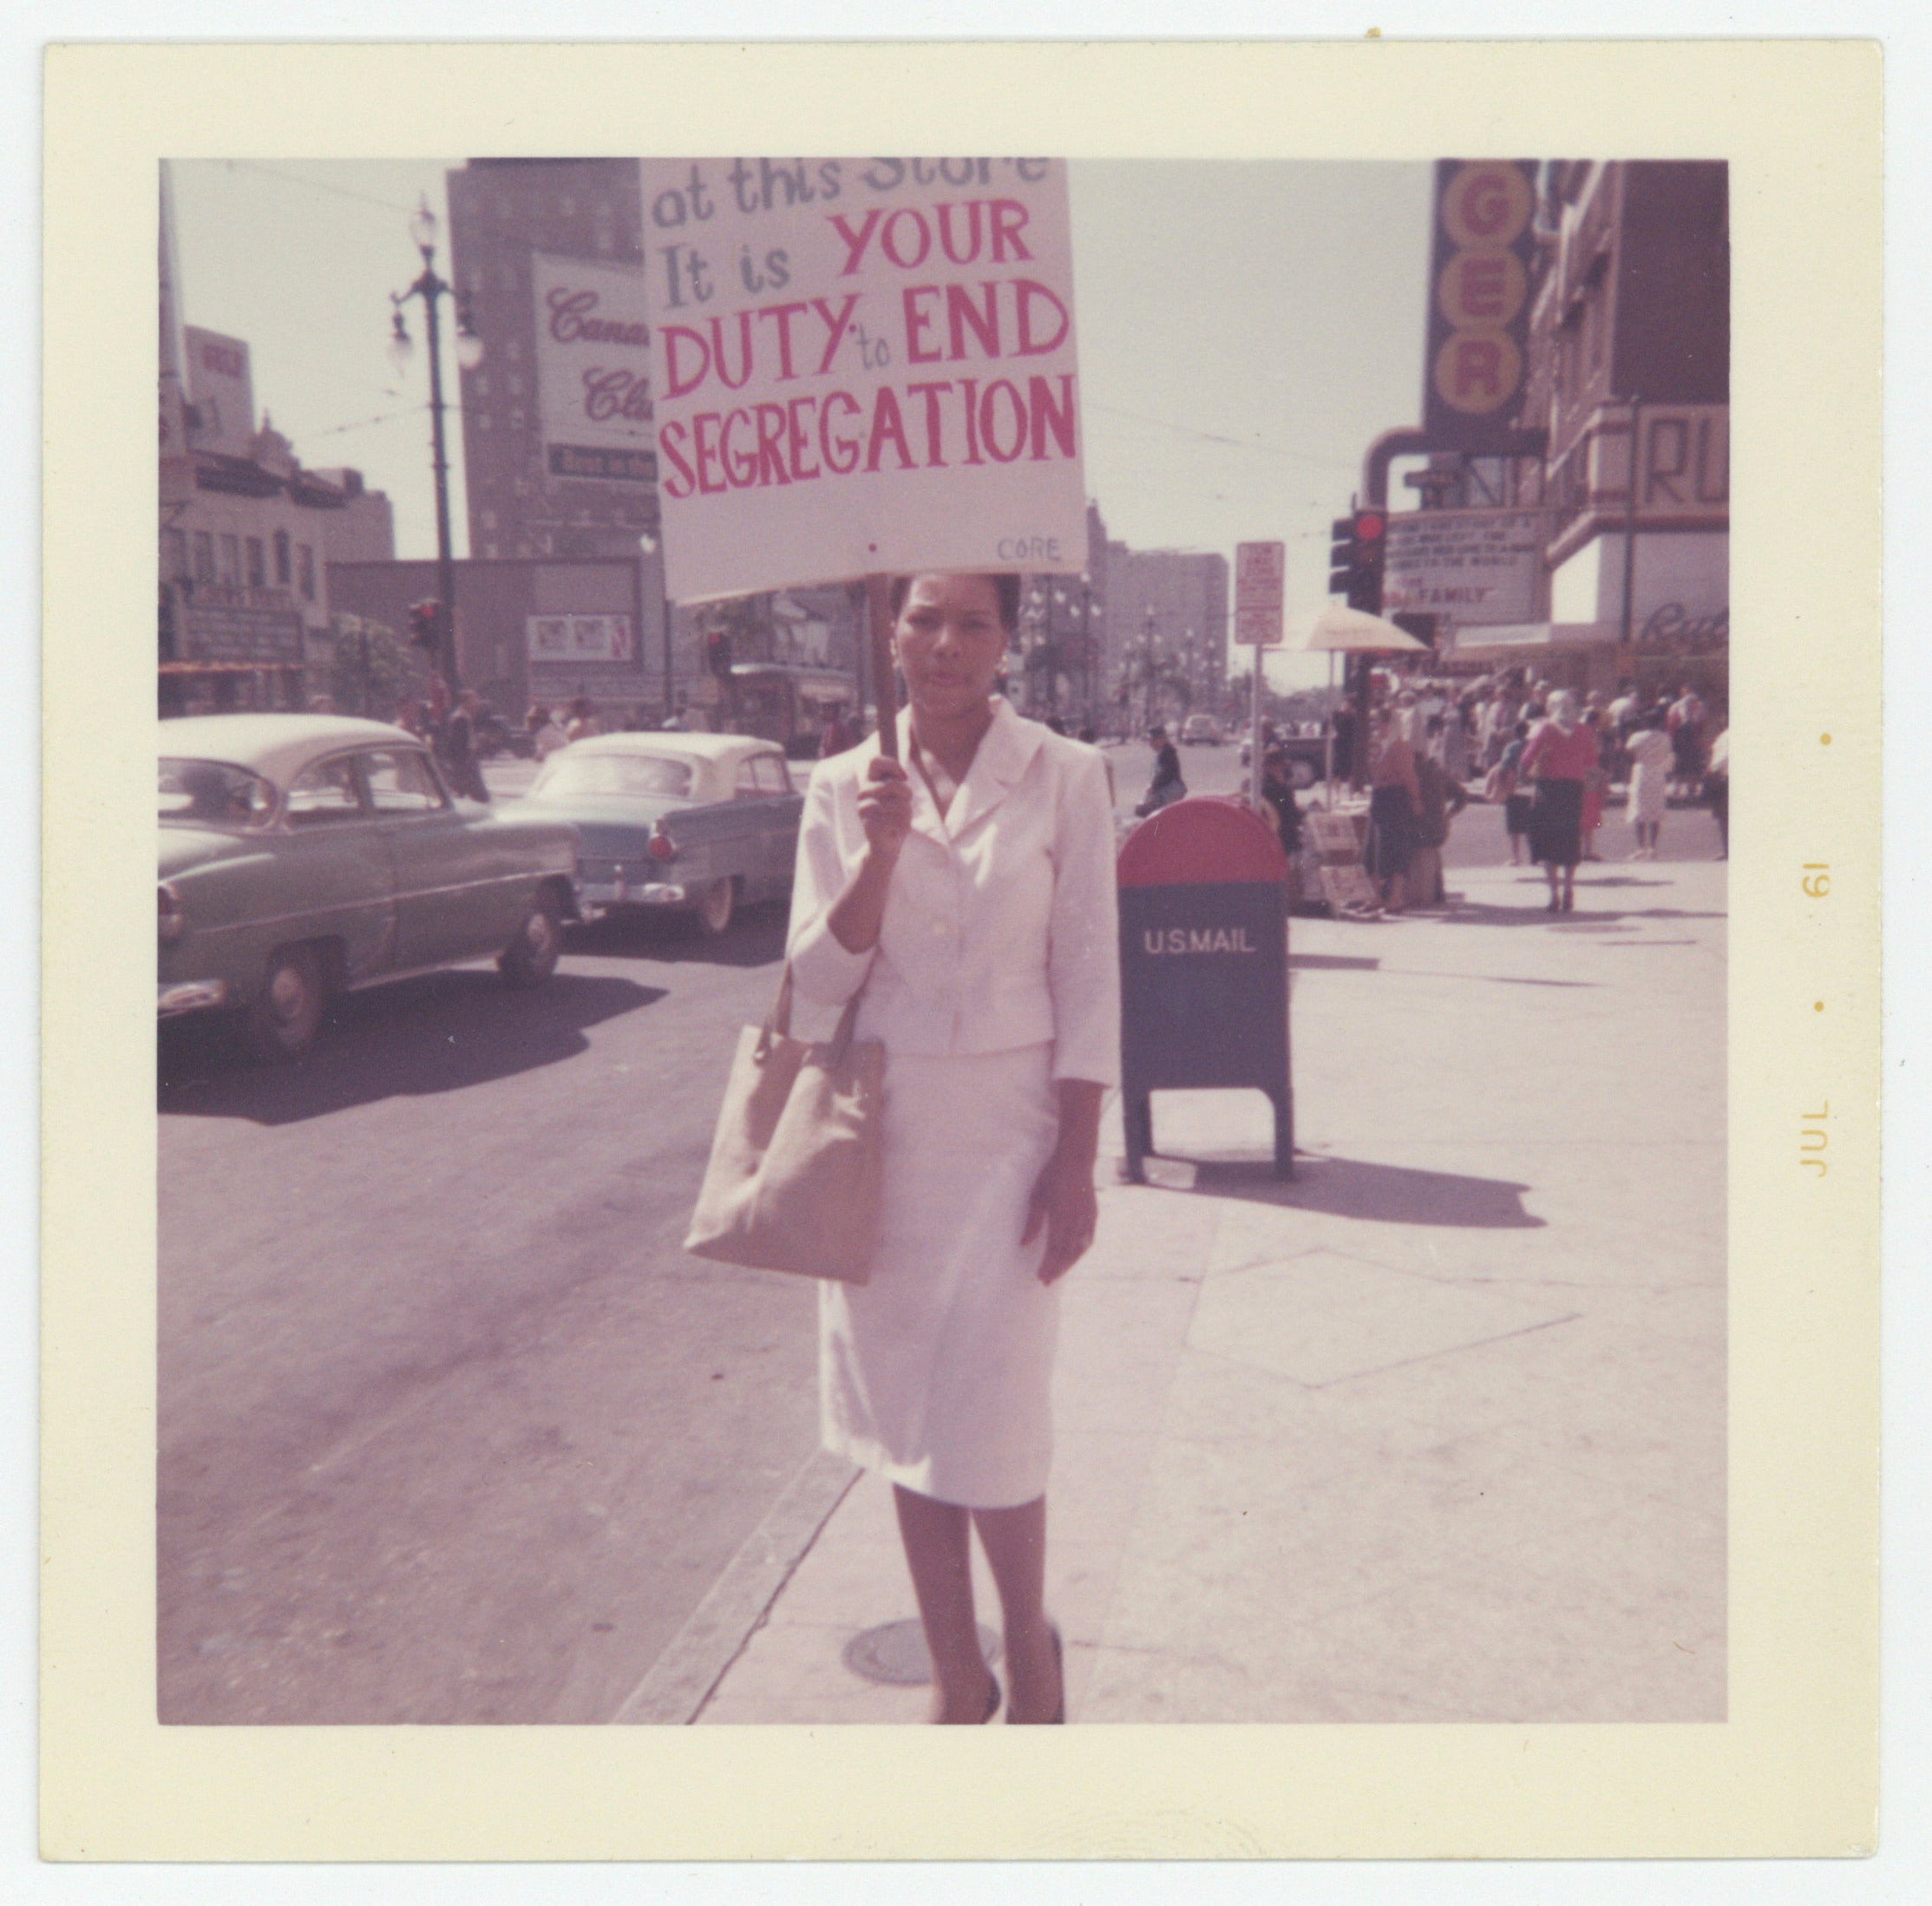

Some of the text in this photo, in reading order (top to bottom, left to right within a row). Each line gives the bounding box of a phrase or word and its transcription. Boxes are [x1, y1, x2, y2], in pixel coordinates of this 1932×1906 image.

[652, 164, 714, 228] at
[729, 158, 842, 215] this
[657, 198, 1036, 310] It is YOUR
[658, 278, 1070, 401] DUTY to END
[658, 373, 1076, 499] SEGREGATION
[997, 535, 1061, 562] CORE
